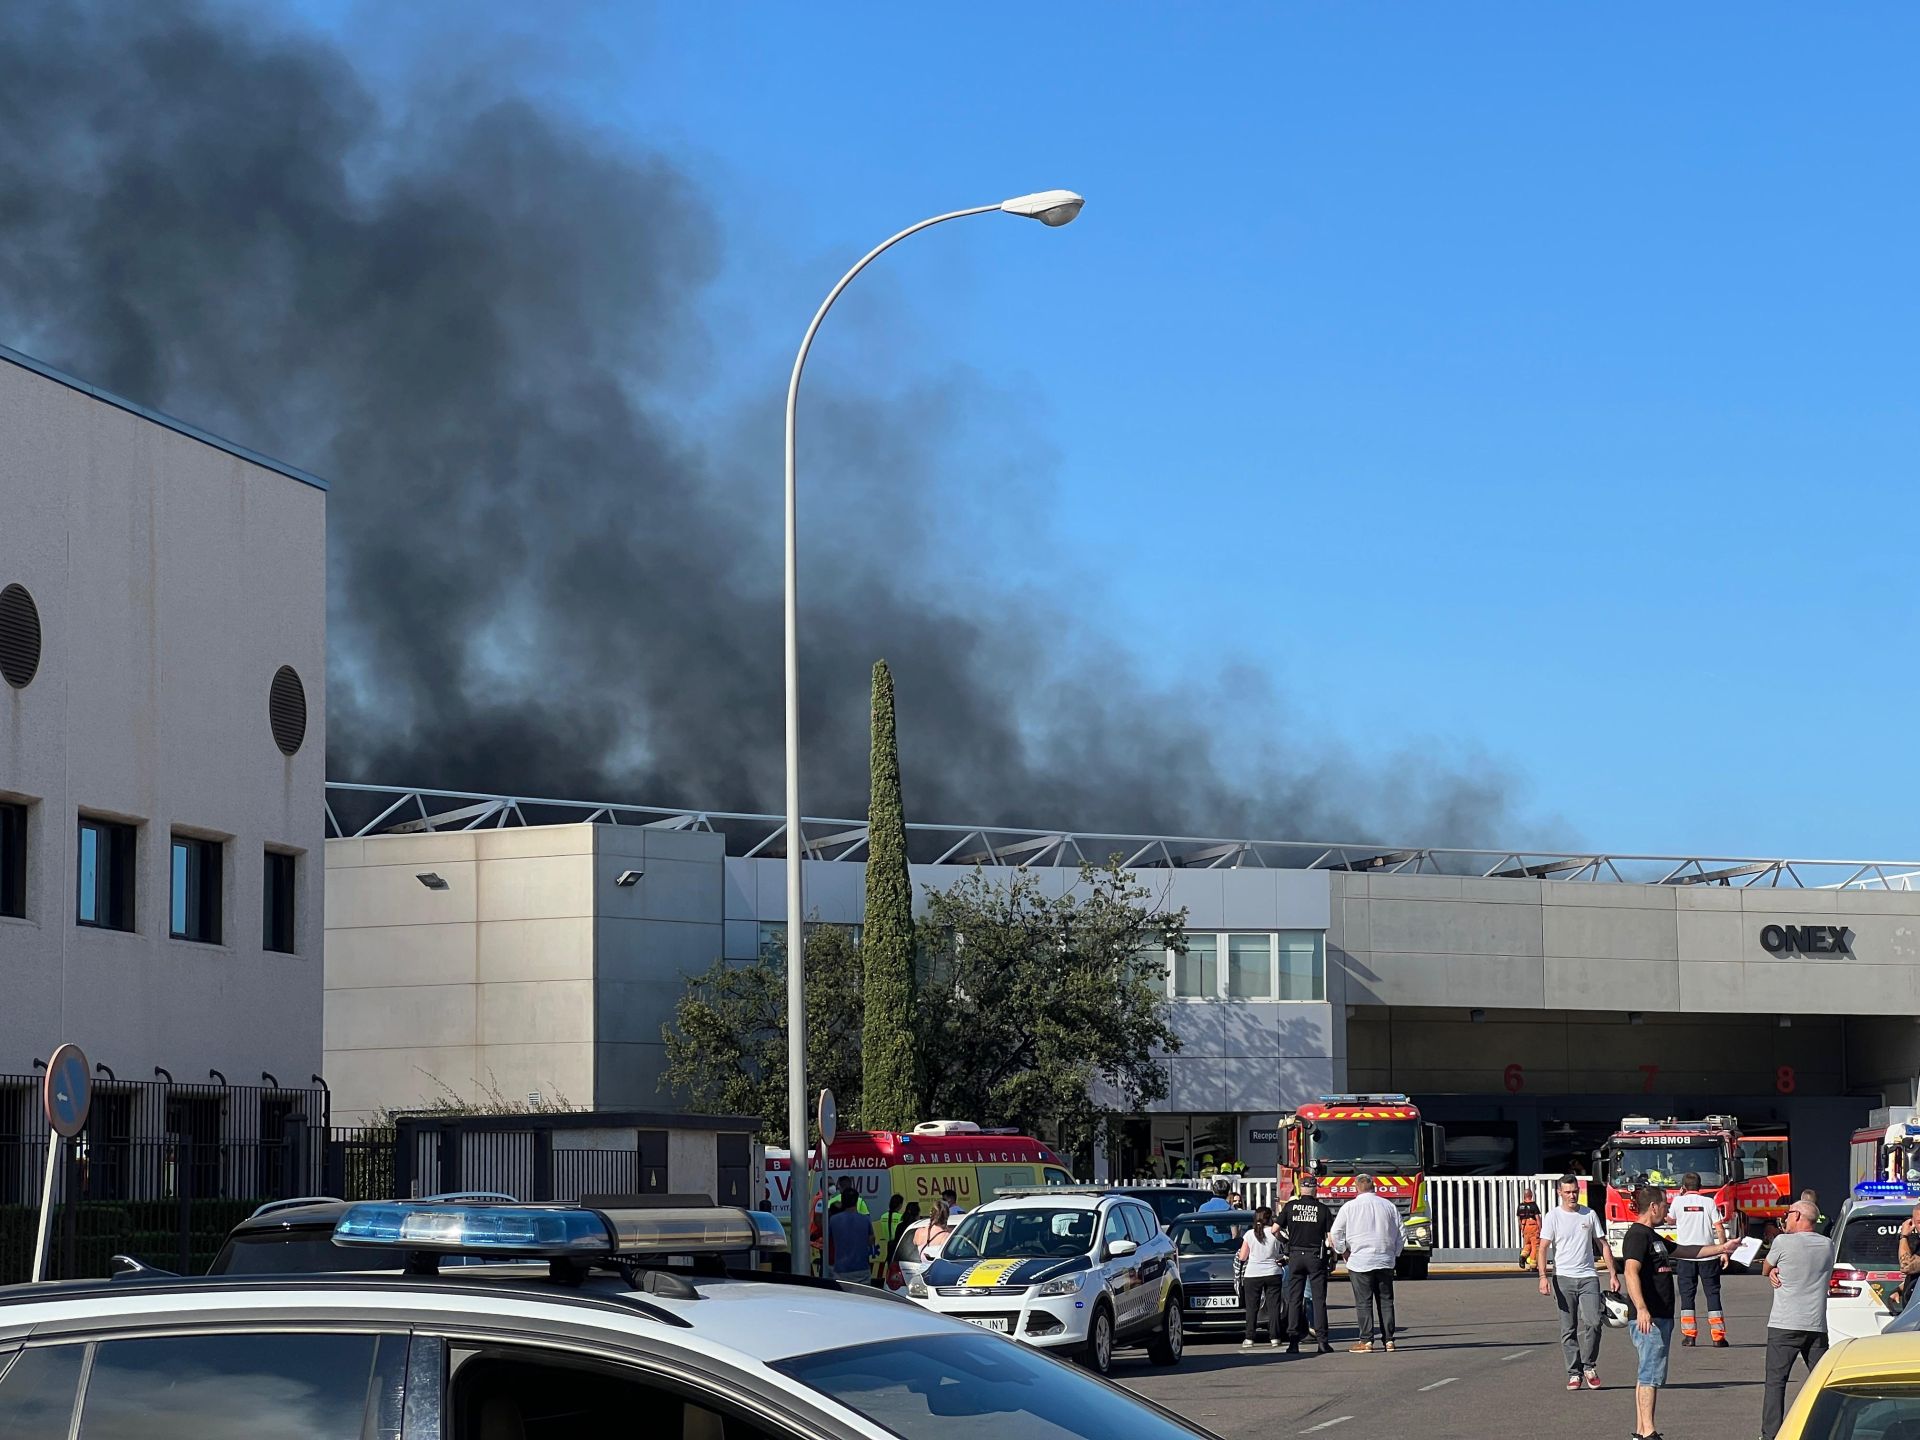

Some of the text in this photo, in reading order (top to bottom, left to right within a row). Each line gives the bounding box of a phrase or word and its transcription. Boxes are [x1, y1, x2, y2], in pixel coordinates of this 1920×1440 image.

[1760, 924, 1849, 953] ONEX
[1503, 1063, 1524, 1093] 6
[1638, 1064, 1660, 1093] 7
[1775, 1065, 1796, 1093] 8
[1252, 1131, 1278, 1141] Recepci
[919, 1151, 1028, 1163] AMBULÀNCIA
[916, 1176, 970, 1196] SAMU
